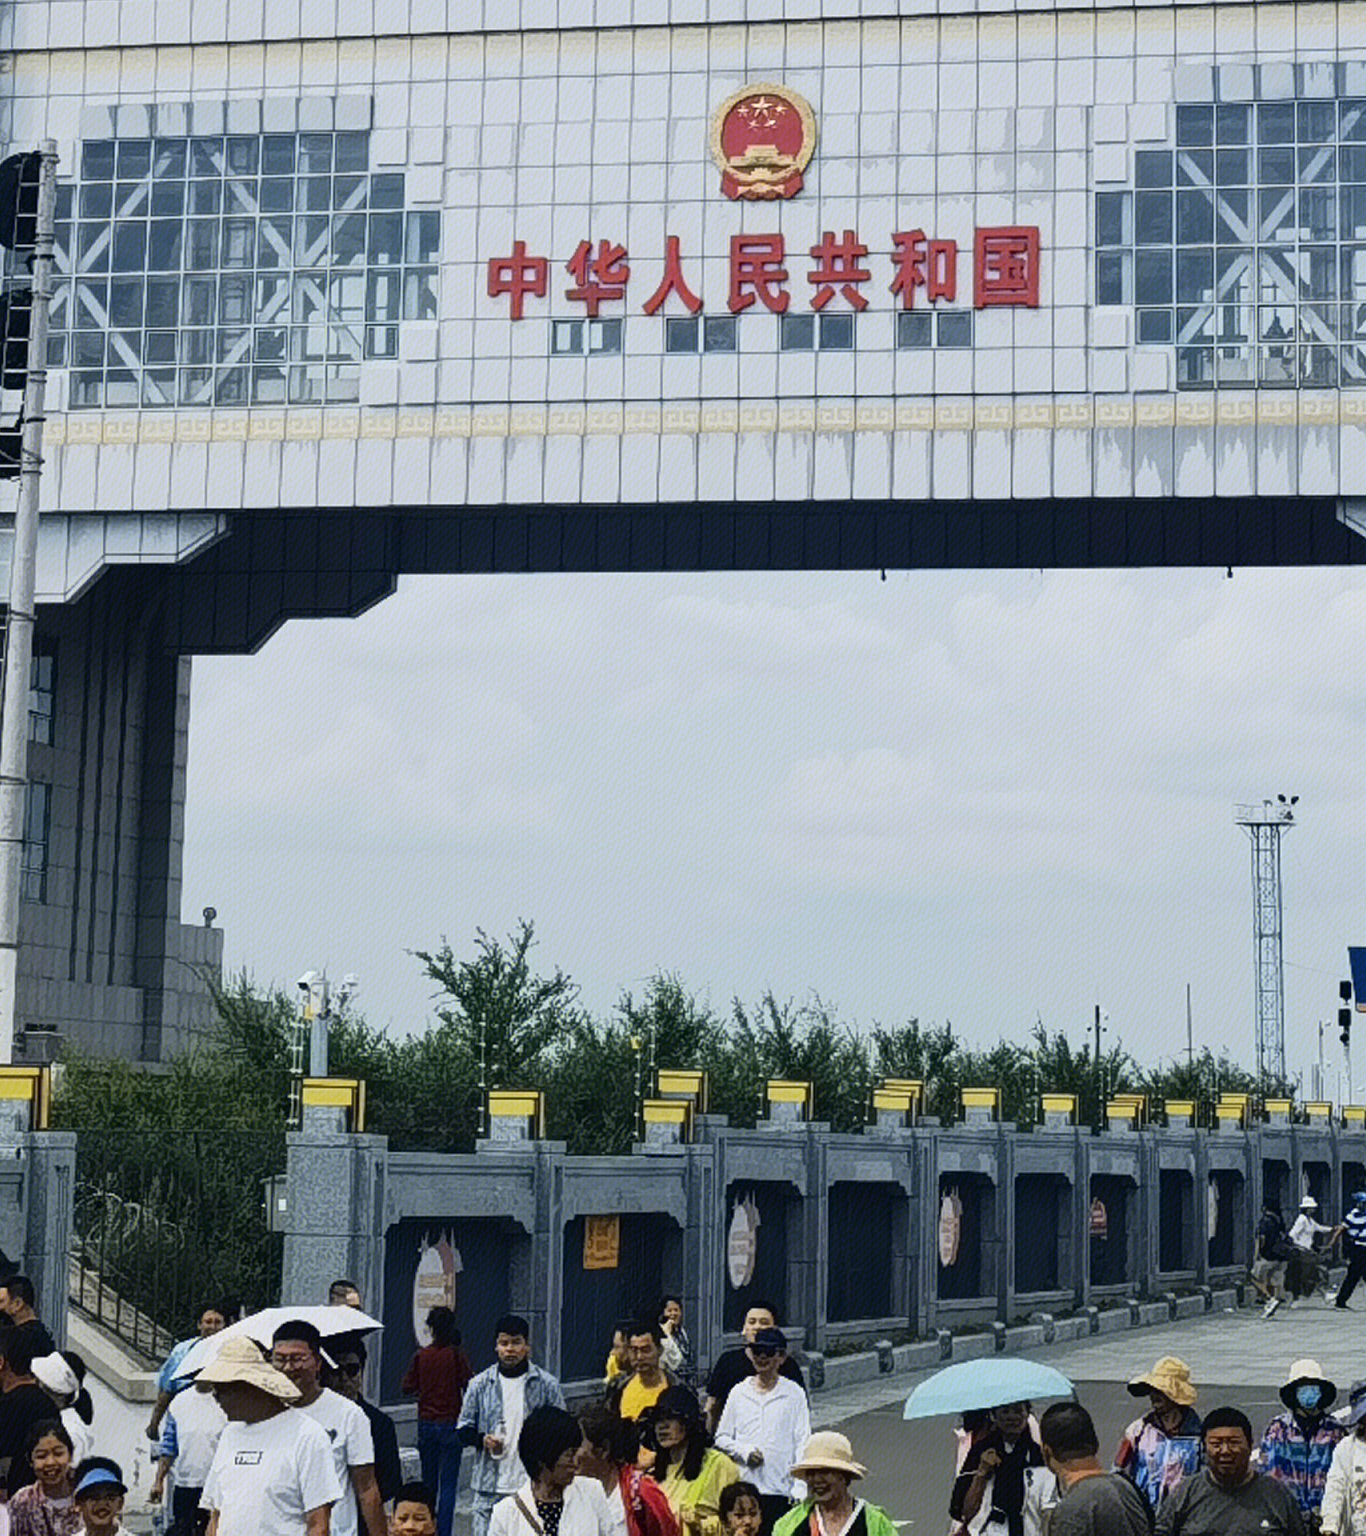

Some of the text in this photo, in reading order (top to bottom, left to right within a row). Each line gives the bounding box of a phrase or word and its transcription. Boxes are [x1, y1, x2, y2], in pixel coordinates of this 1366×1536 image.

[486, 225, 1041, 321] 中华人民共和国
